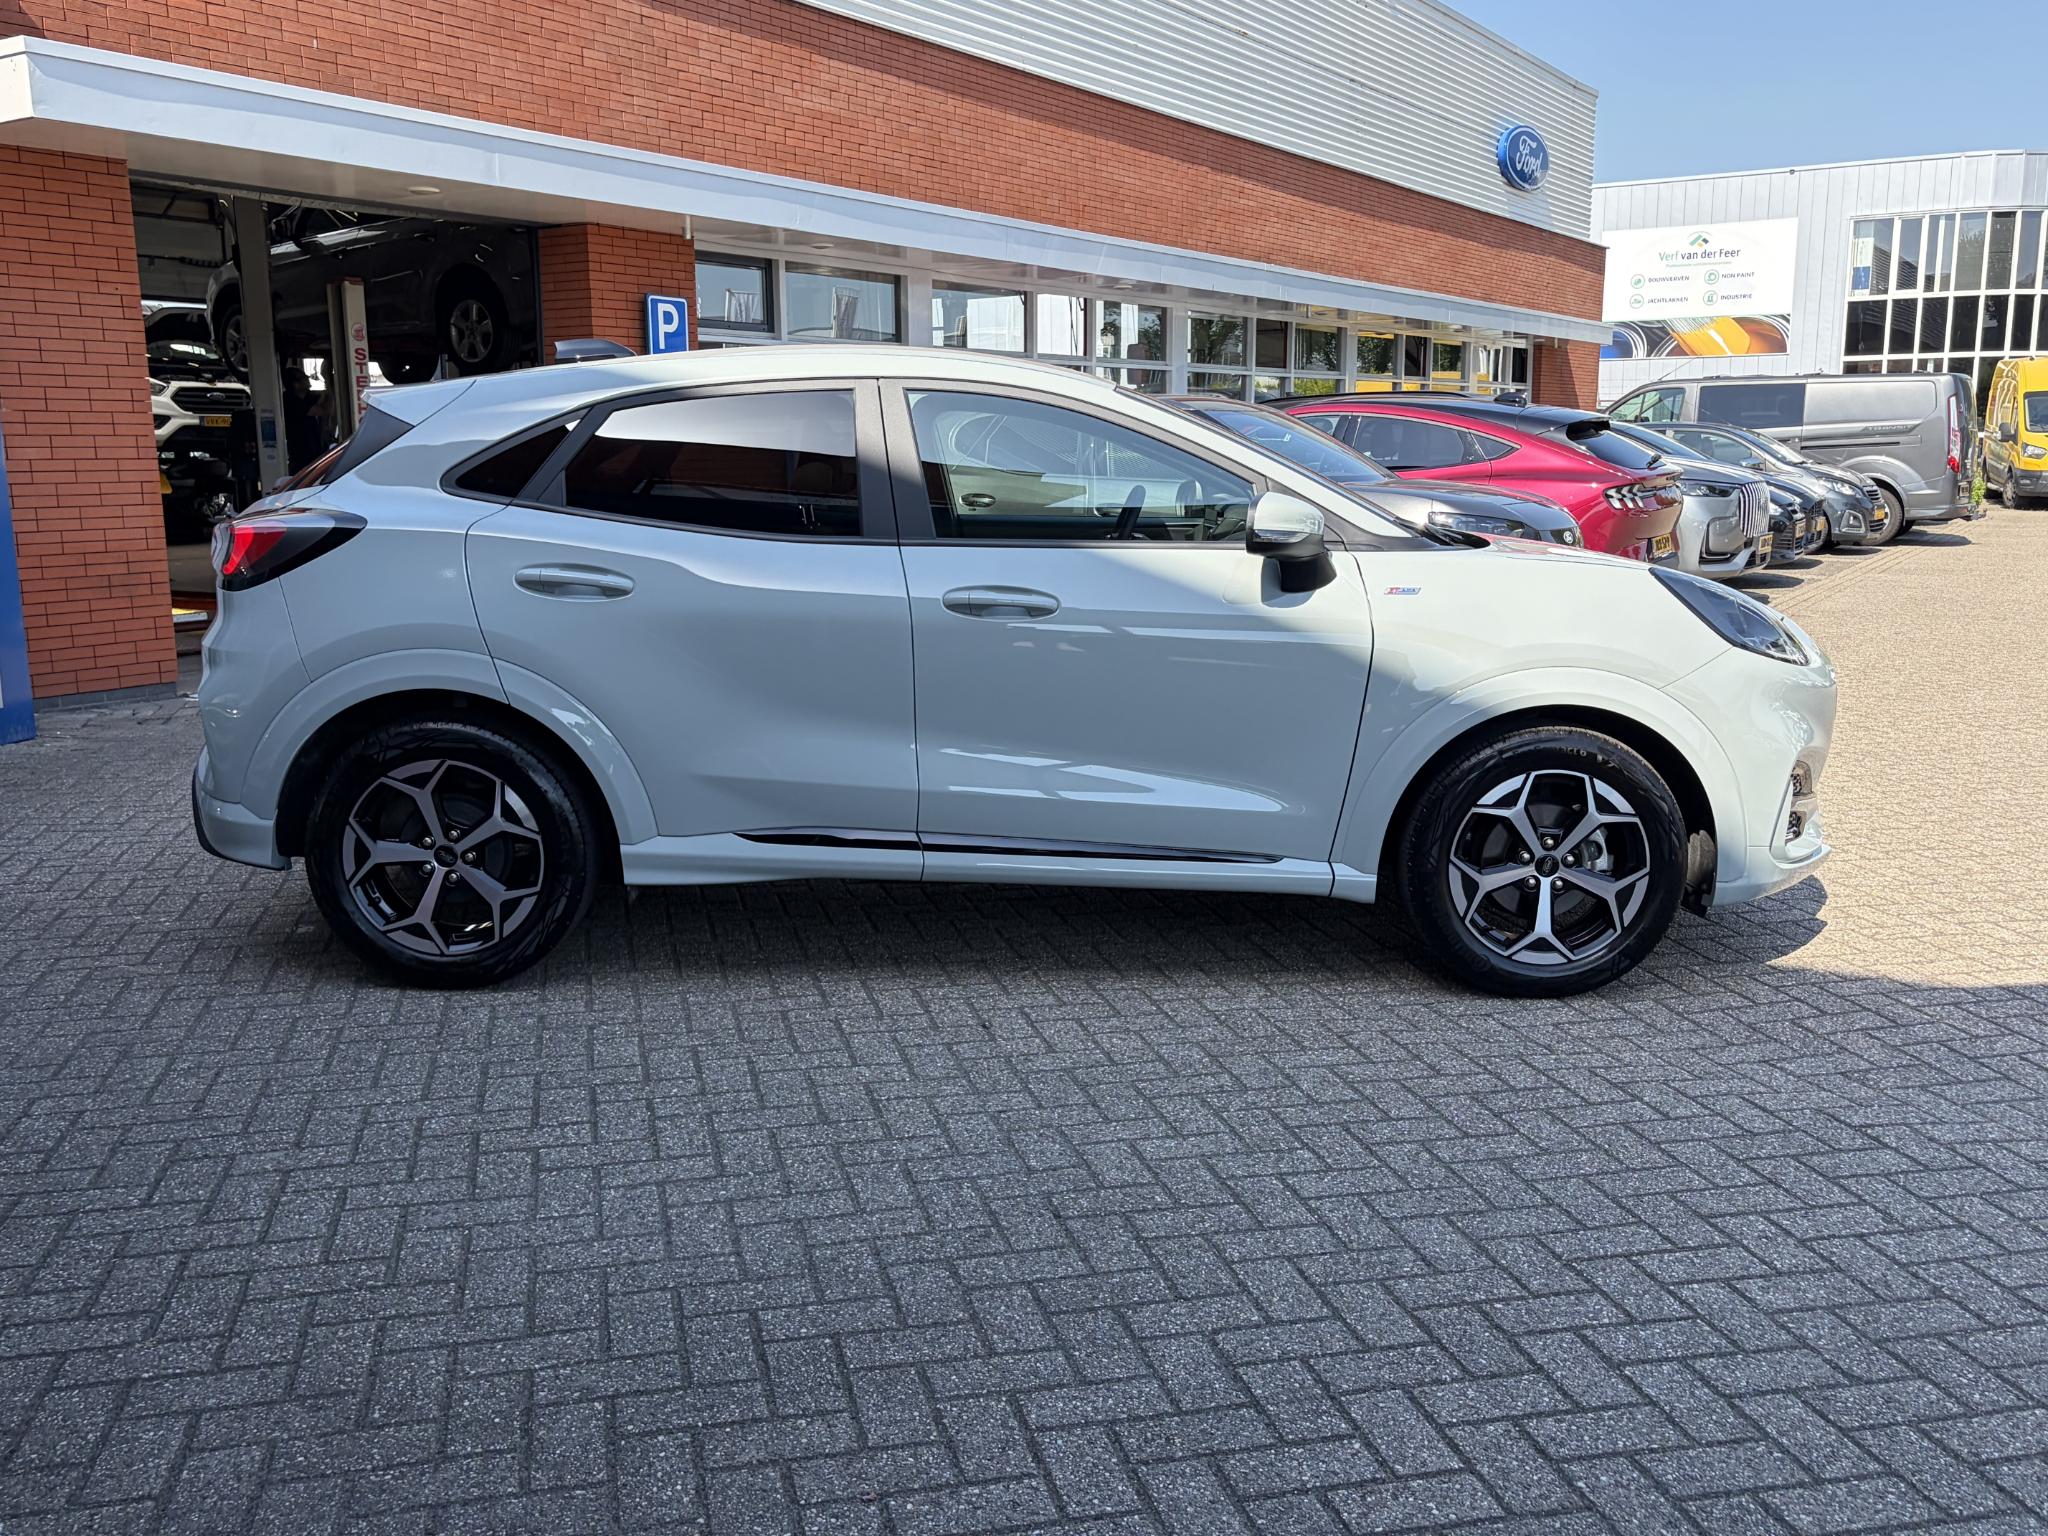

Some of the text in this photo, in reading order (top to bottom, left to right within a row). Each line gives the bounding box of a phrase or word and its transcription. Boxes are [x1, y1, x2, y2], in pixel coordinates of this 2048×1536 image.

[1515, 135, 1543, 177] Ford
[1659, 248, 1741, 261] Verf van der Feer
[1736, 271, 1755, 279] PAINT
[1720, 293, 1753, 301] INDUSTRIE
[657, 302, 679, 350] P
